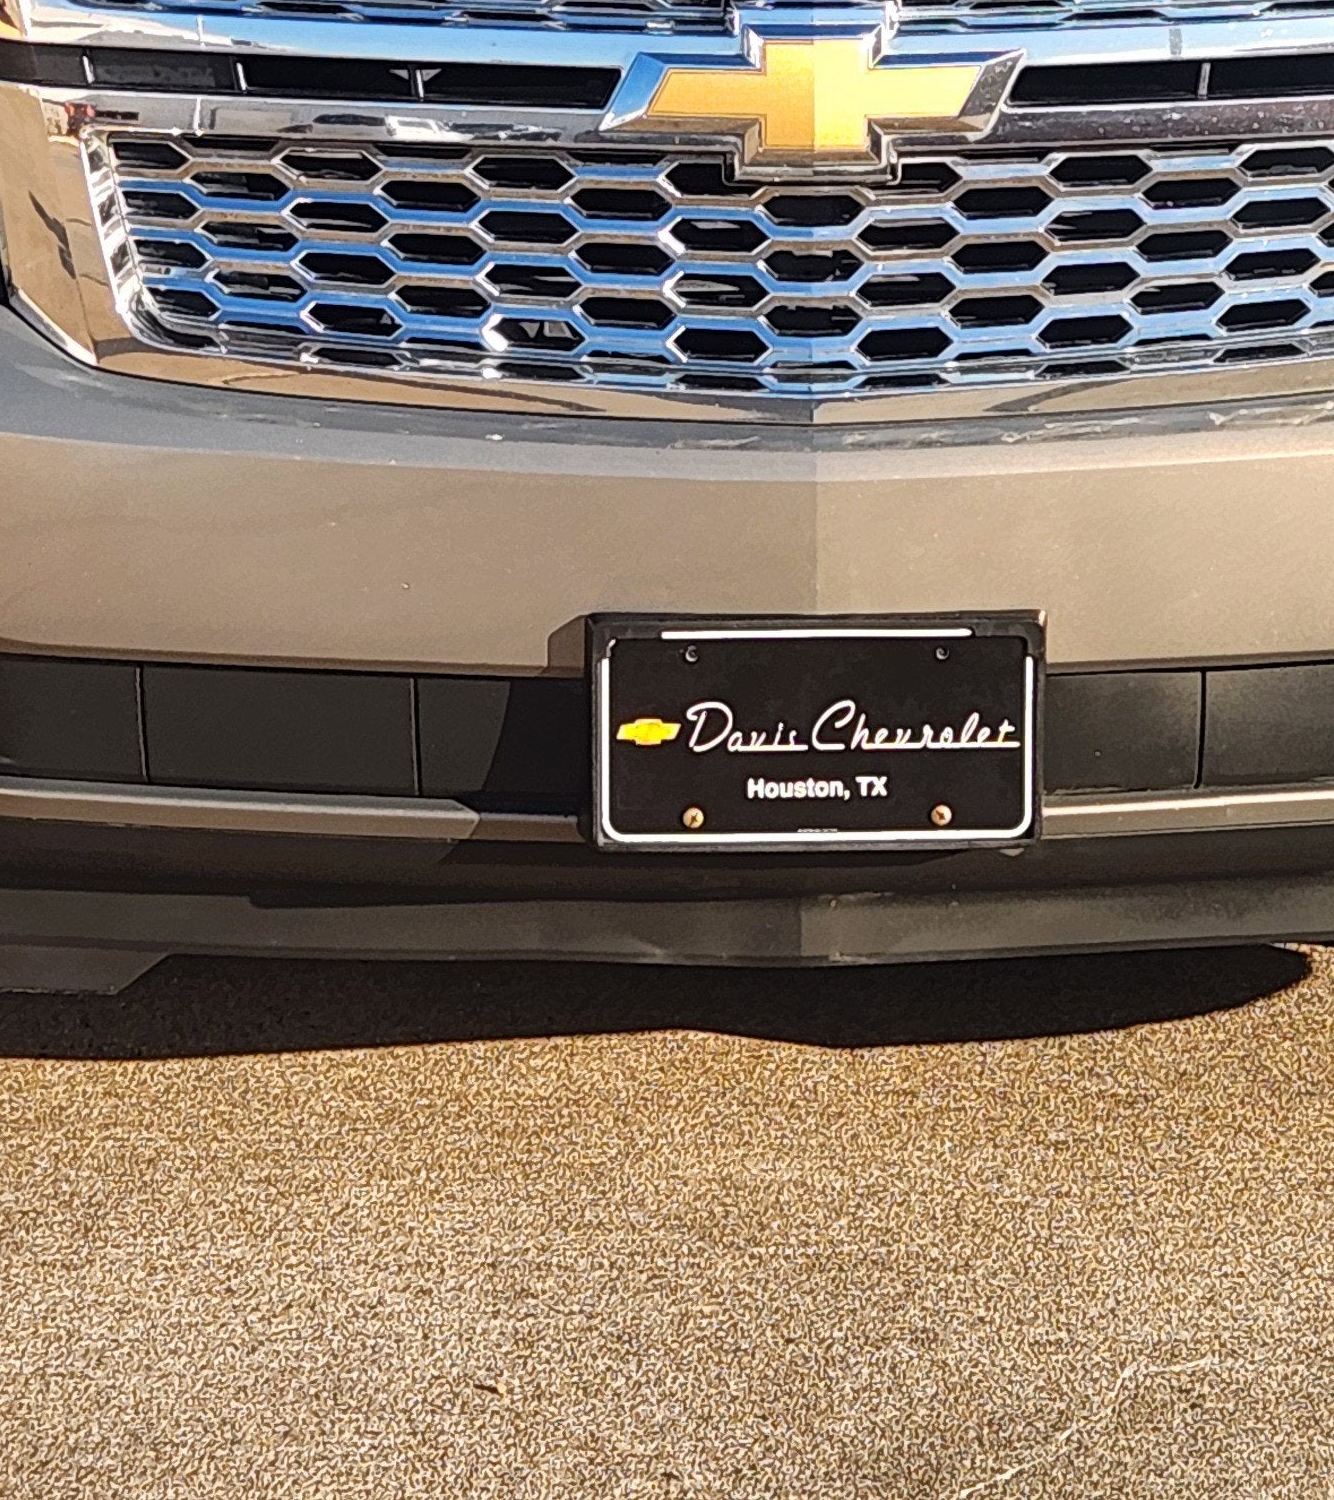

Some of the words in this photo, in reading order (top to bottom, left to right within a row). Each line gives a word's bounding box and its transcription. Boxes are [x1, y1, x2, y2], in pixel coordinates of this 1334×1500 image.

[685, 700, 809, 753] Davis
[811, 699, 1021, 752] Chevrolet
[746, 776, 851, 801] Houston,
[855, 776, 888, 797] TX
